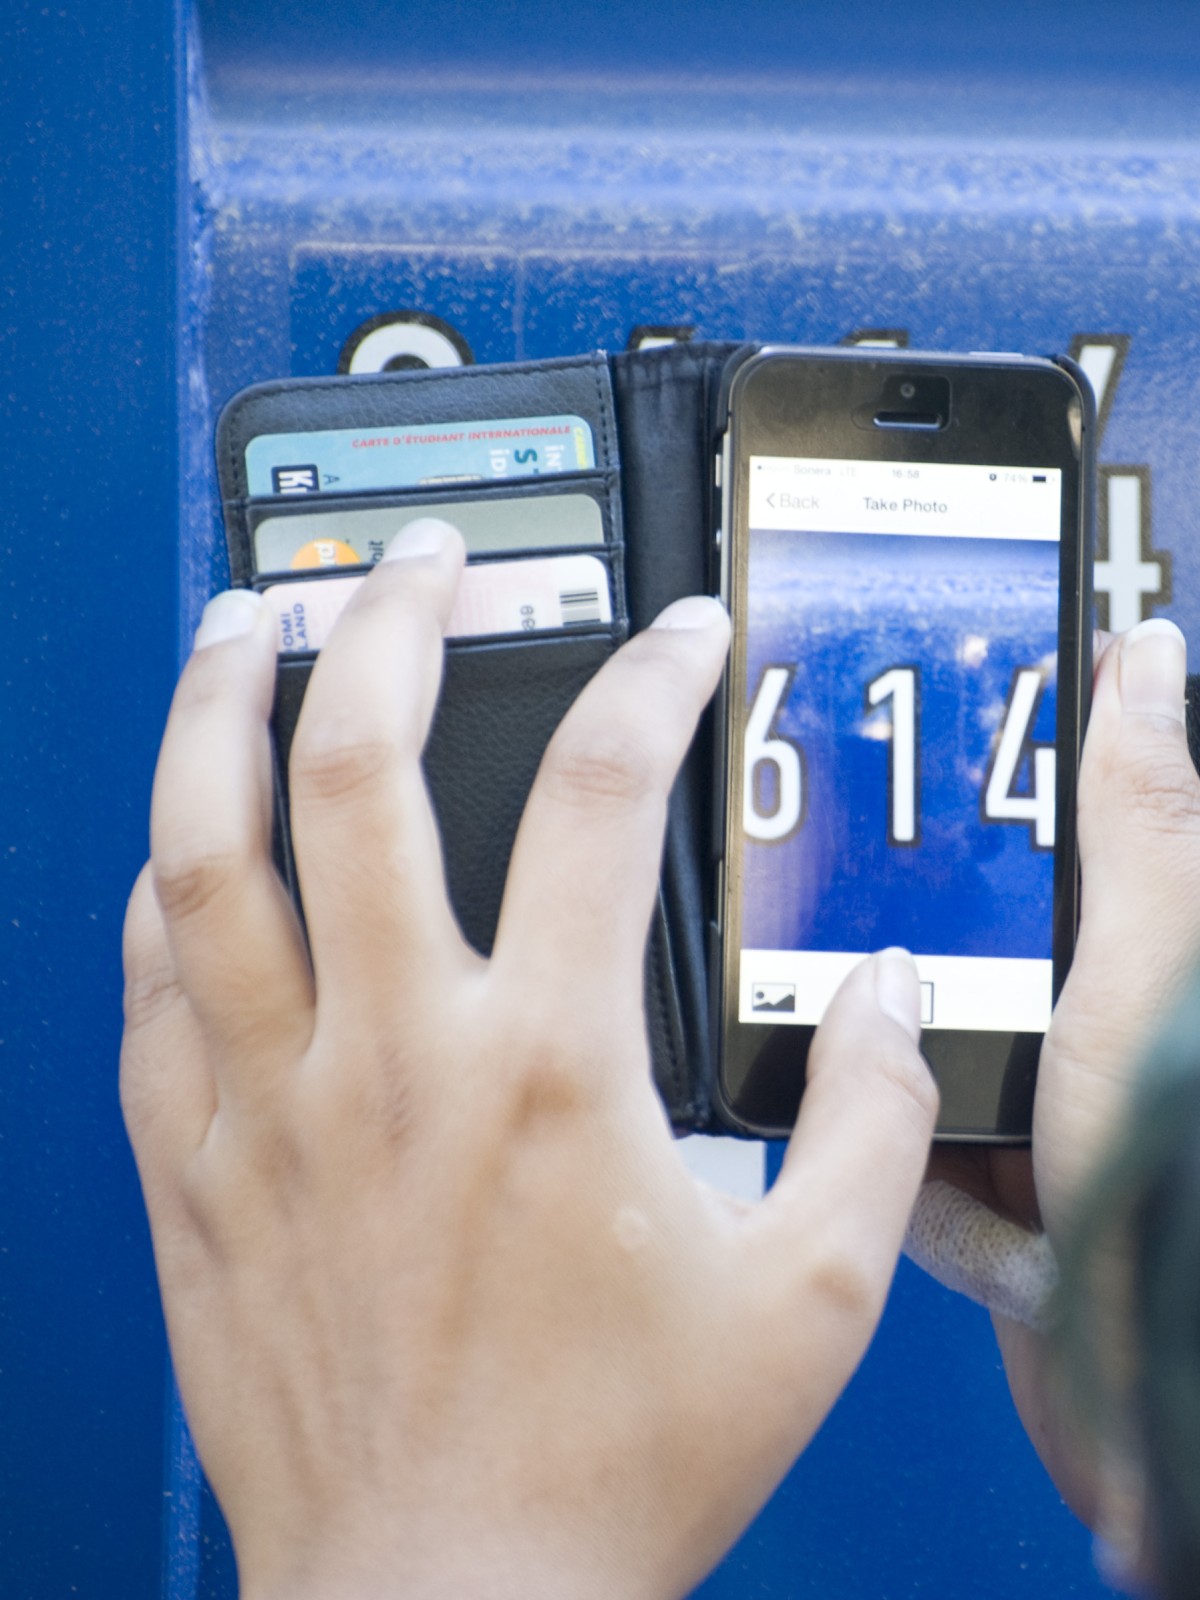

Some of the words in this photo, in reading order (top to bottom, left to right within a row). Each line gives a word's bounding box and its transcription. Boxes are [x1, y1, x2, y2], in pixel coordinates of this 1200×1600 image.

[352, 437, 390, 449] CARTE
[468, 425, 572, 440] INTERNATIONALE
[793, 464, 832, 477] Sonera
[892, 468, 920, 480] 16:58
[779, 491, 821, 511] Back
[862, 495, 899, 512] Take
[902, 497, 949, 514] Photo
[280, 613, 294, 654] OMI
